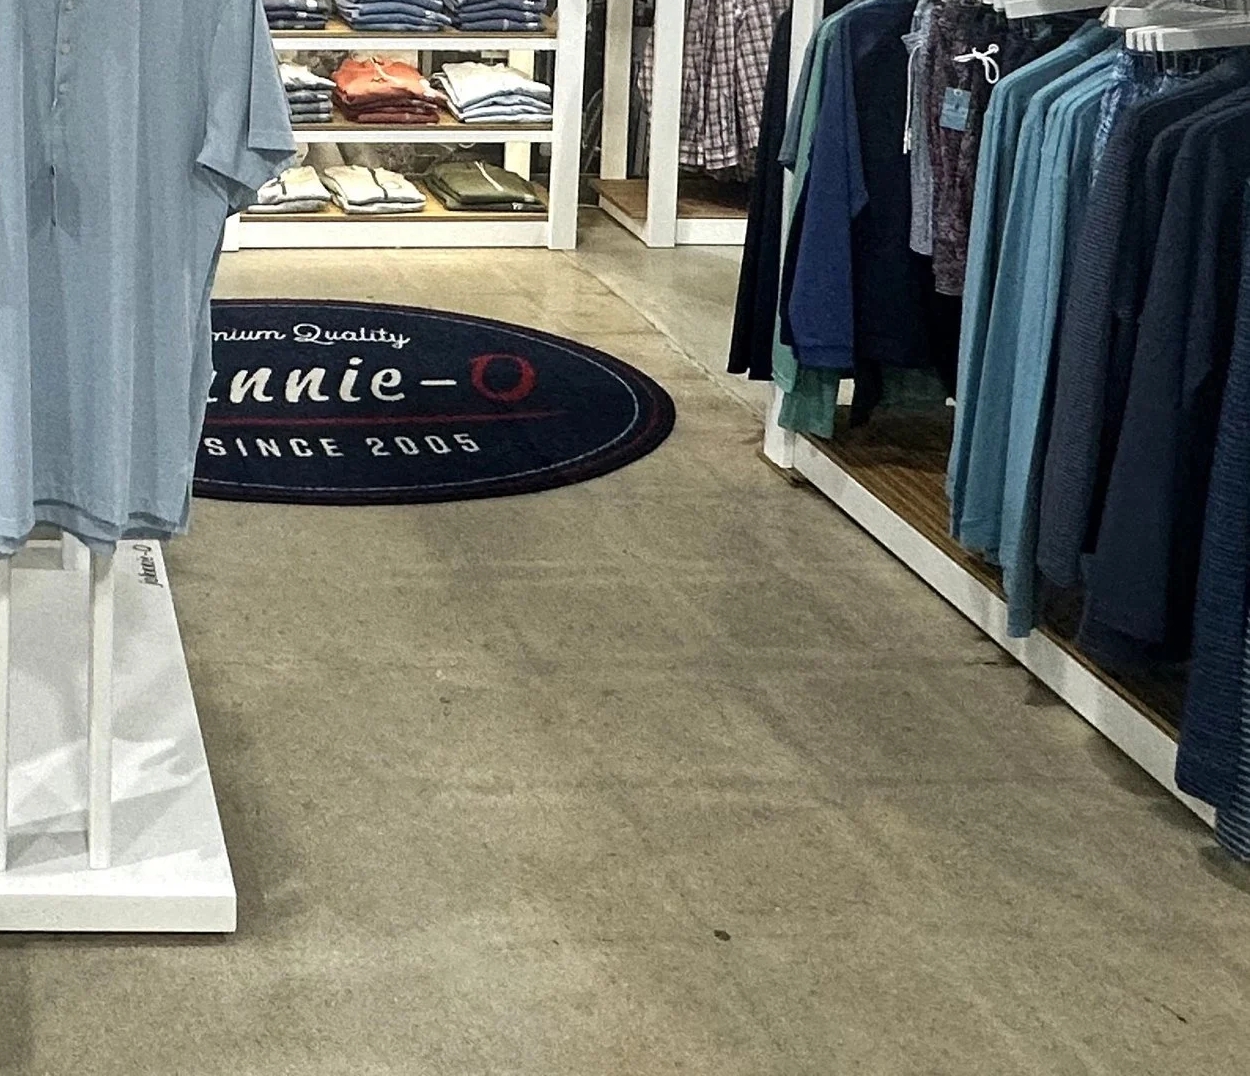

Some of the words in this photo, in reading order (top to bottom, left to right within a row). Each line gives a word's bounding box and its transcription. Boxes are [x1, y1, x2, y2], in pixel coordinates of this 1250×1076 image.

[293, 323, 411, 349] Quality
[207, 351, 539, 404] nnie-O
[203, 436, 344, 457] SINCE
[365, 433, 480, 457] 2005
